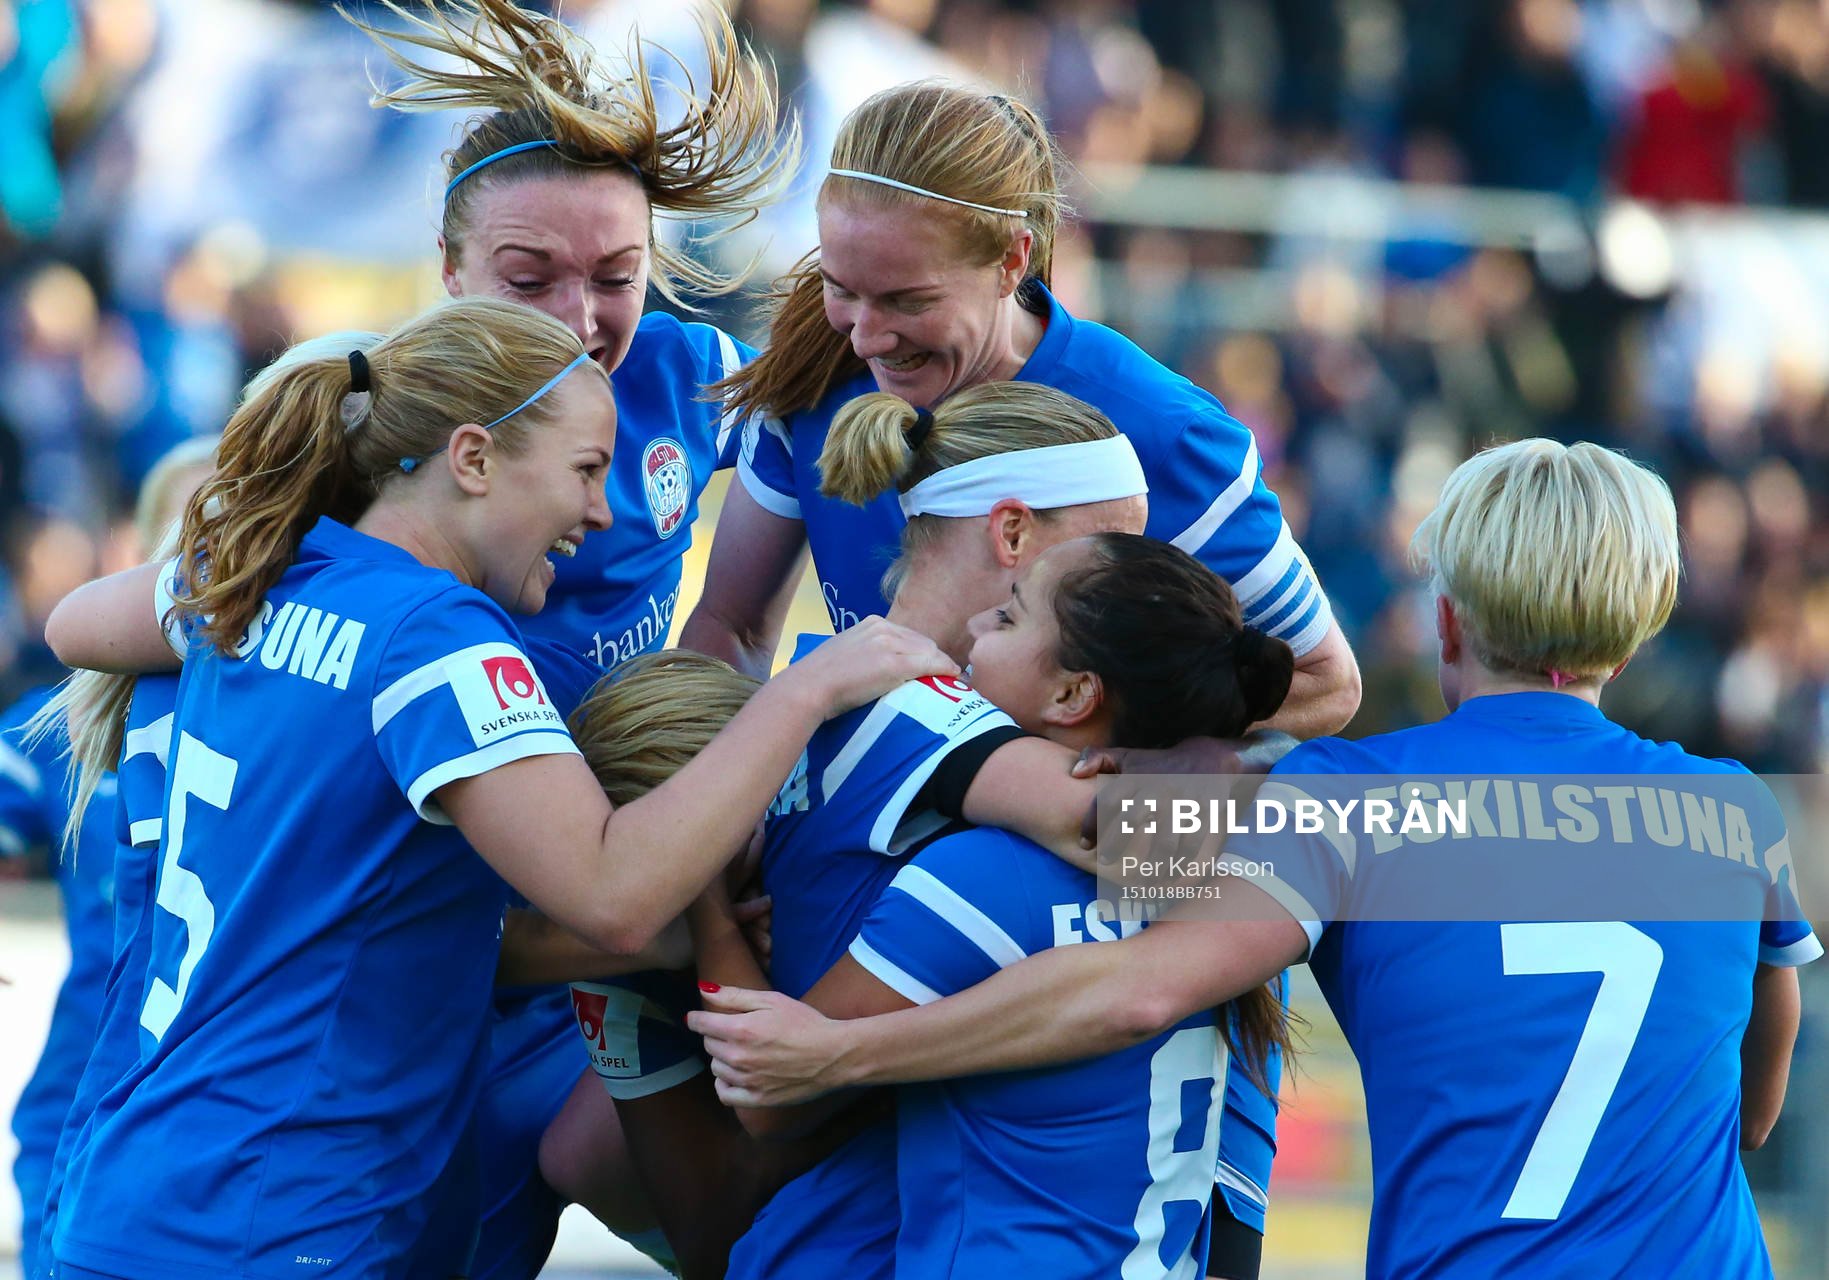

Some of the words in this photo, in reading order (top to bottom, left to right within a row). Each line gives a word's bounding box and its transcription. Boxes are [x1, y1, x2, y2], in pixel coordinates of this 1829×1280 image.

[481, 710, 541, 736] SVENSKA
[947, 698, 990, 728] SVENSK
[1363, 779, 1759, 869] ESKILSTUNA
[139, 729, 238, 1043] 5
[600, 1056, 629, 1068] SPEL
[1500, 921, 1664, 1220] 7
[1121, 1025, 1228, 1280] 8
[295, 1255, 332, 1266] DRI-FIT
